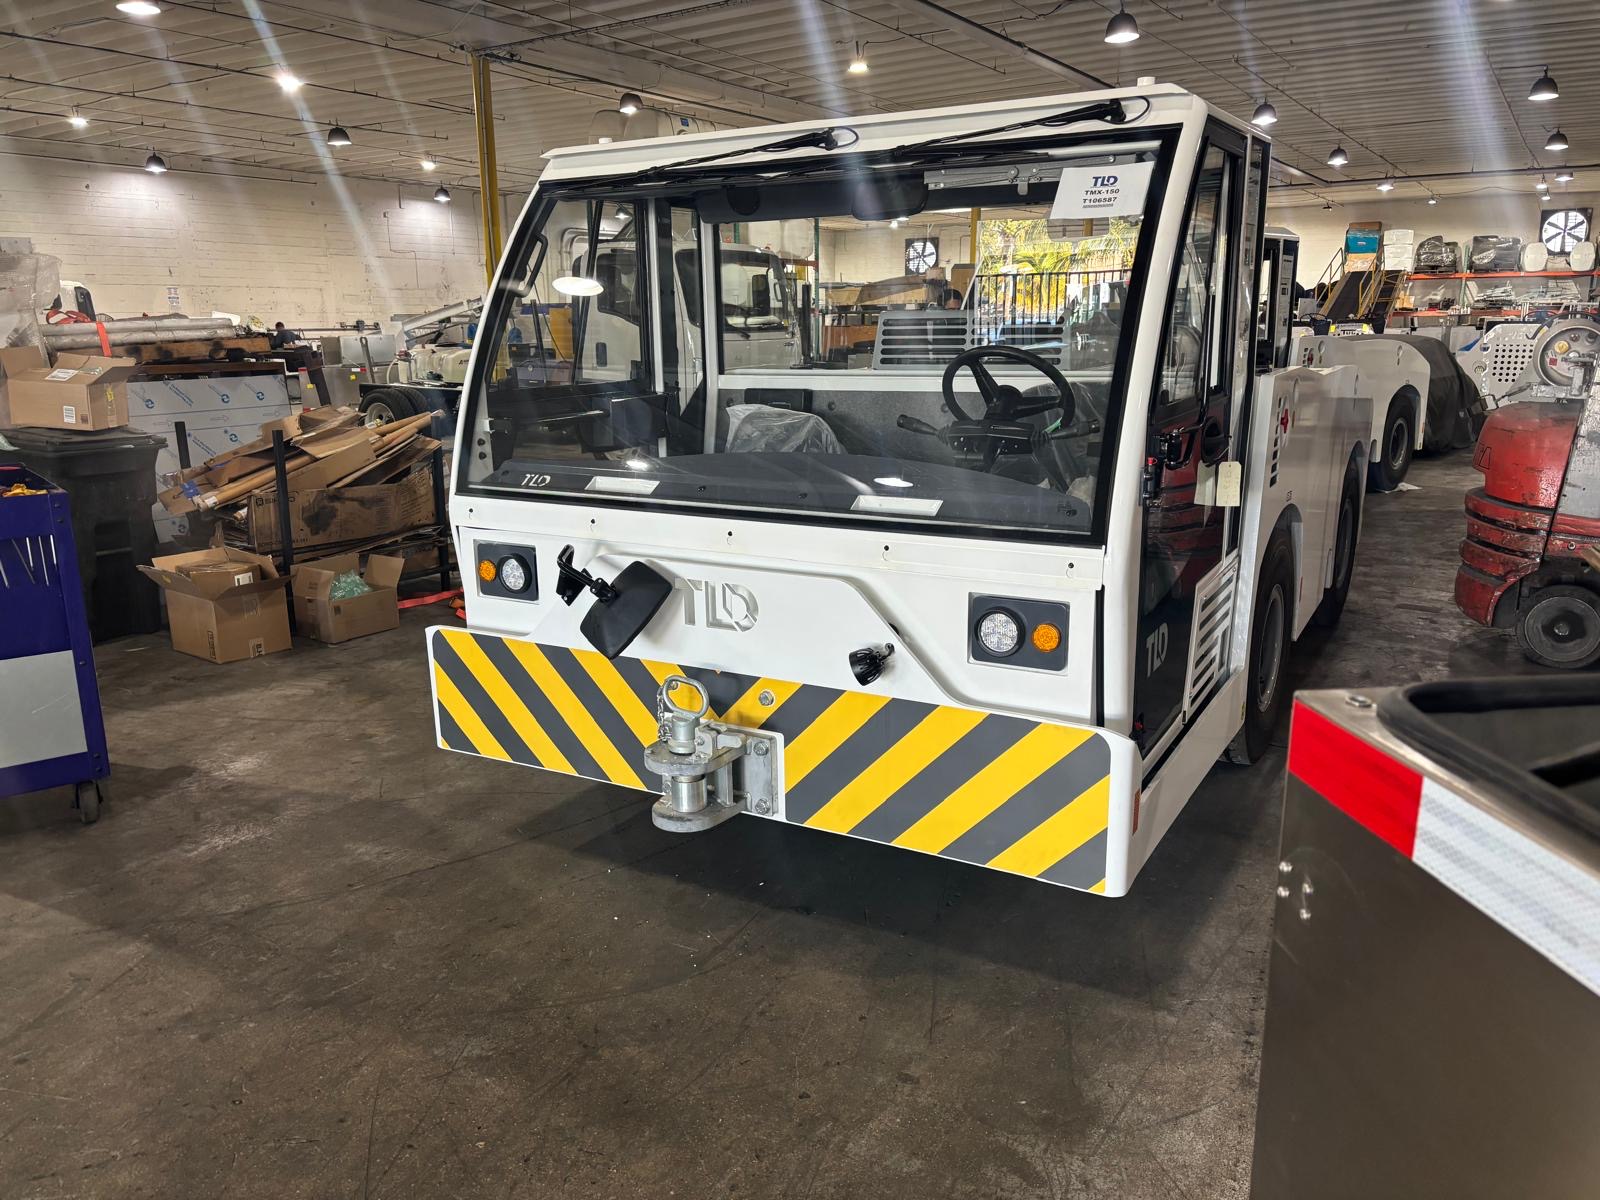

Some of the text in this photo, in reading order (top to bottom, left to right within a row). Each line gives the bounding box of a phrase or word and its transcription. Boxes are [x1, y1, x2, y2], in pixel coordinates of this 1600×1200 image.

[1092, 175, 1119, 187] TLD
[1085, 188, 1120, 196] TMX-150
[1082, 196, 1118, 204] T106587
[521, 473, 551, 487] TLD
[674, 576, 759, 633] TLD
[1146, 622, 1169, 679] TLD
